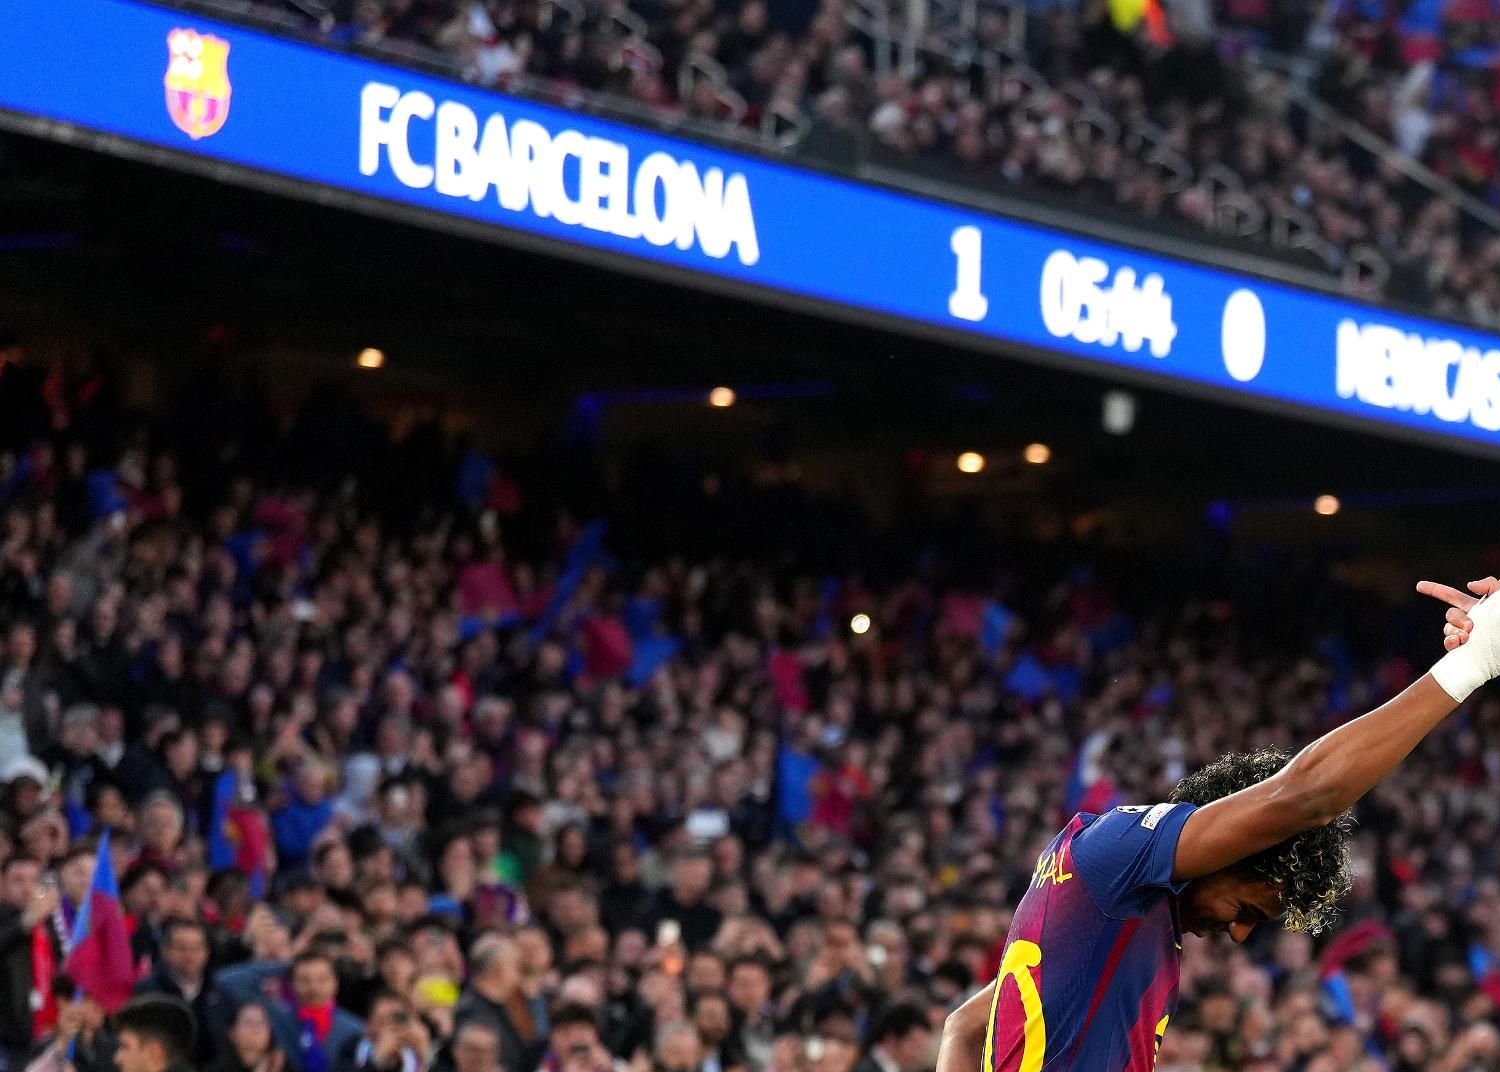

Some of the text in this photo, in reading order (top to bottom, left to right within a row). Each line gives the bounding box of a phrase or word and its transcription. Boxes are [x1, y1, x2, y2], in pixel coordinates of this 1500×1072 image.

[359, 81, 760, 266] FC BARCELONA
[948, 225, 988, 322] 1
[1221, 288, 1266, 382] 0
